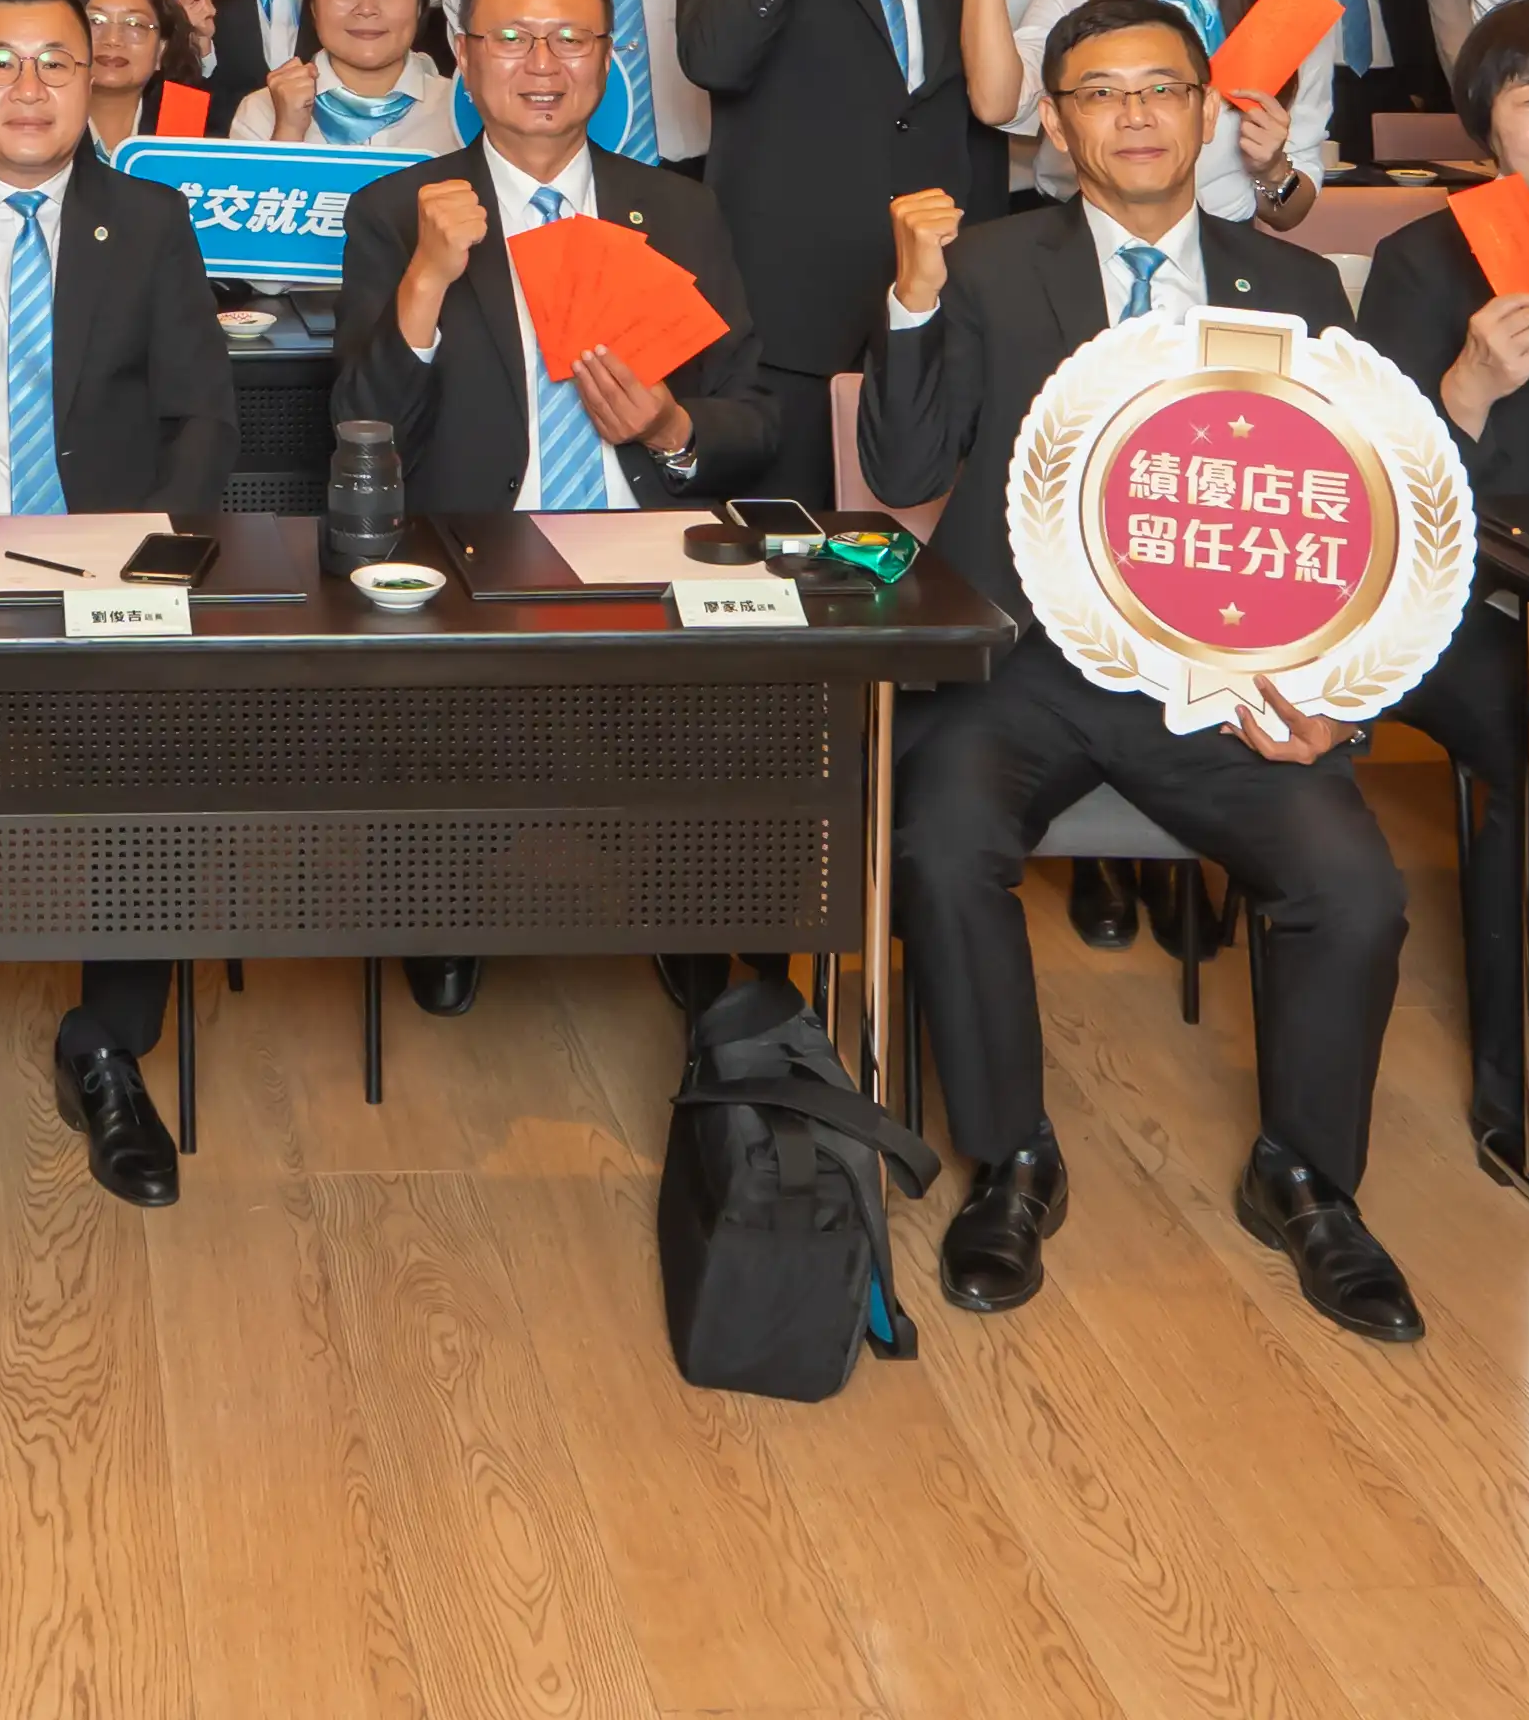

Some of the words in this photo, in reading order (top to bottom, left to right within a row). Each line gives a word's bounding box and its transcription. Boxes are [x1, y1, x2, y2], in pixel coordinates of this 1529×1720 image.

[1129, 449, 1351, 524] 績優店長
[1127, 513, 1347, 588] 留任分紅
